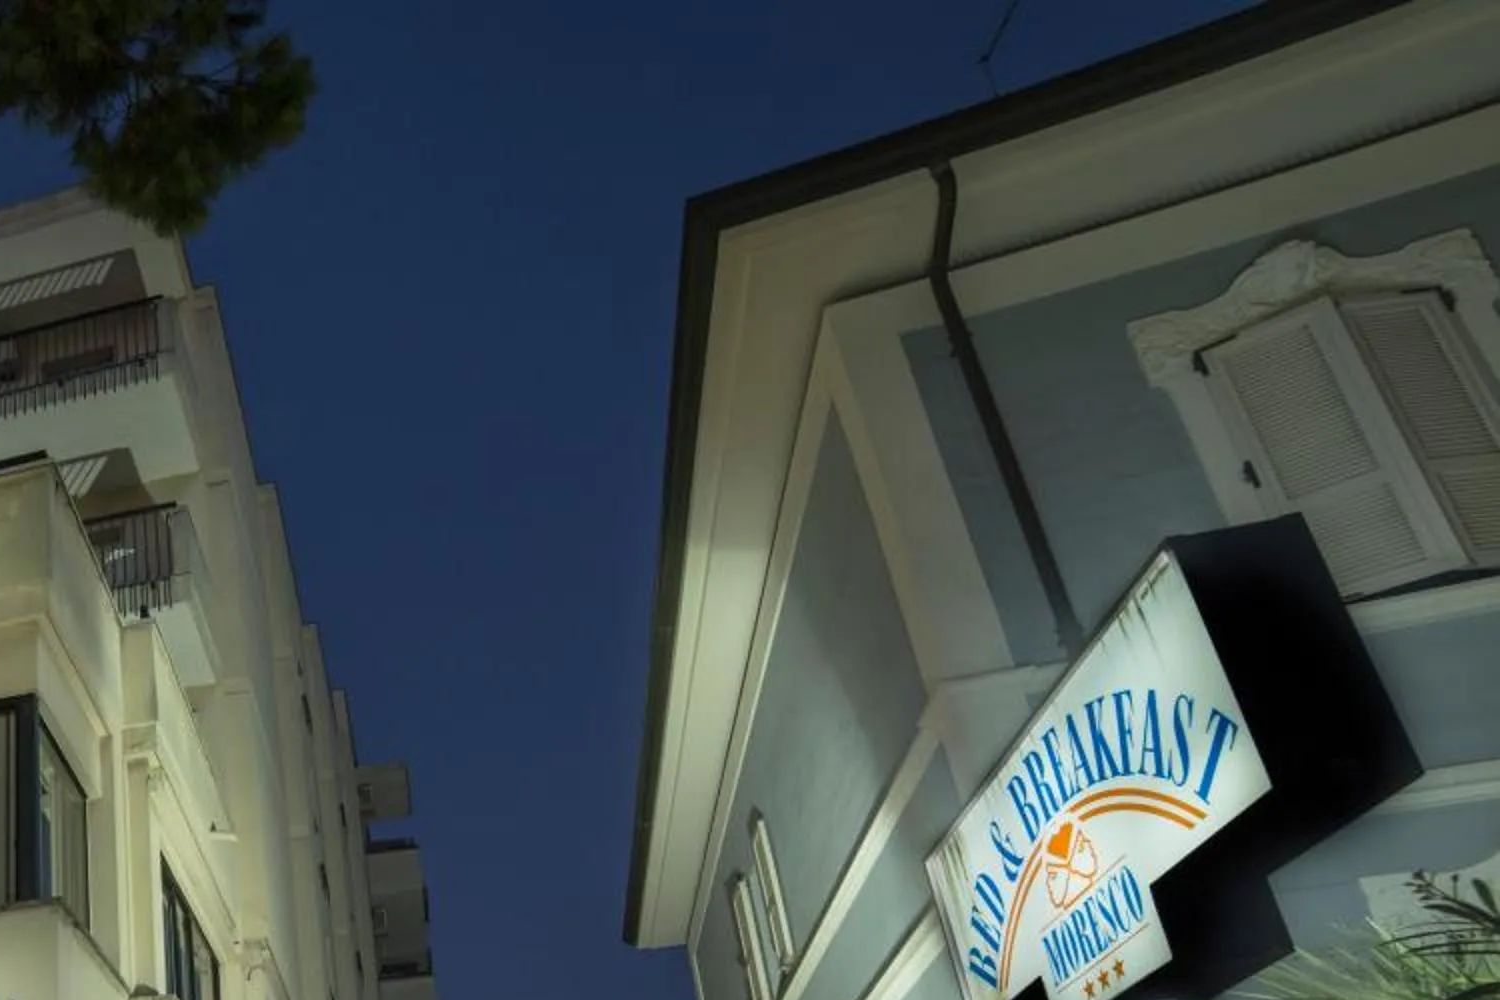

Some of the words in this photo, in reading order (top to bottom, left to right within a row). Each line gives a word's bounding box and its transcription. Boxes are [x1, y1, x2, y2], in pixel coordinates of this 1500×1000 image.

[1007, 689, 1238, 843] BREAKFAST
[990, 821, 1025, 884] &
[968, 872, 1006, 990] BED
[1042, 866, 1144, 987] MORESCO
